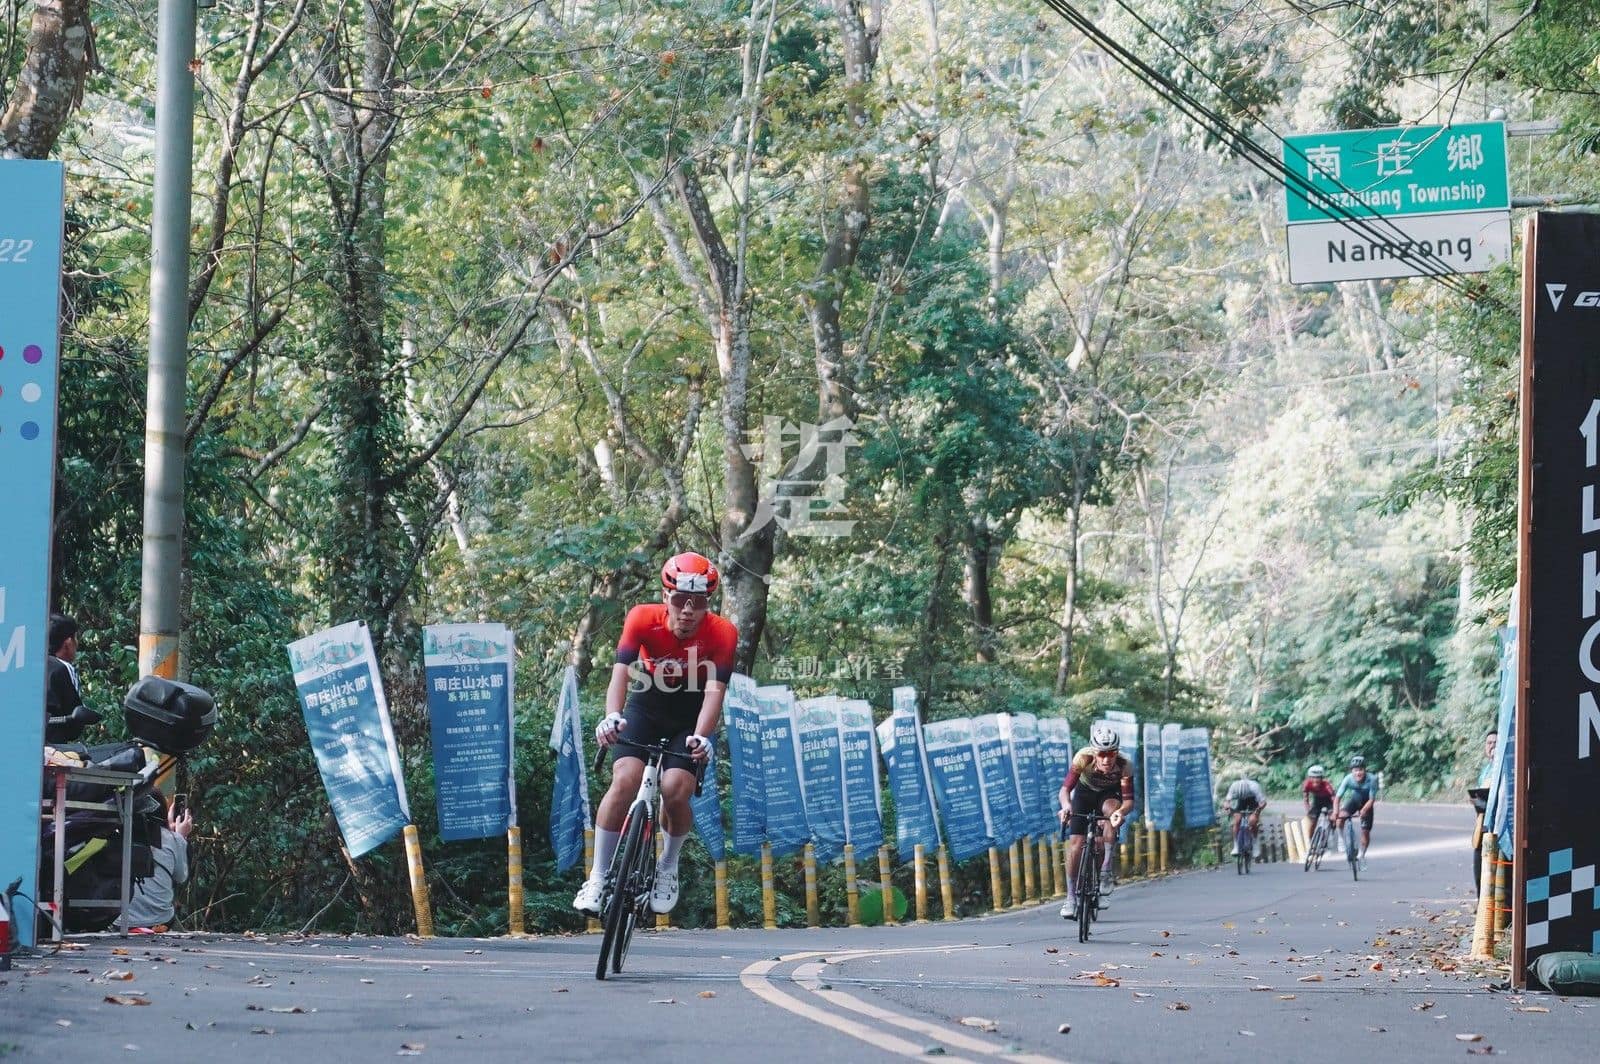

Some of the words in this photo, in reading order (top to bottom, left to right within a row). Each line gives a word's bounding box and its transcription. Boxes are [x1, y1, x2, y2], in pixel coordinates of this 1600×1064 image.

[1304, 134, 1484, 181] 南庄鄉
[1408, 180, 1486, 204] Township
[1327, 237, 1472, 262] Namzong
[688, 577, 695, 590] 1
[305, 675, 367, 710] 南庄山水節
[433, 674, 504, 692] 南庄山水節
[448, 689, 492, 702] 系列活動
